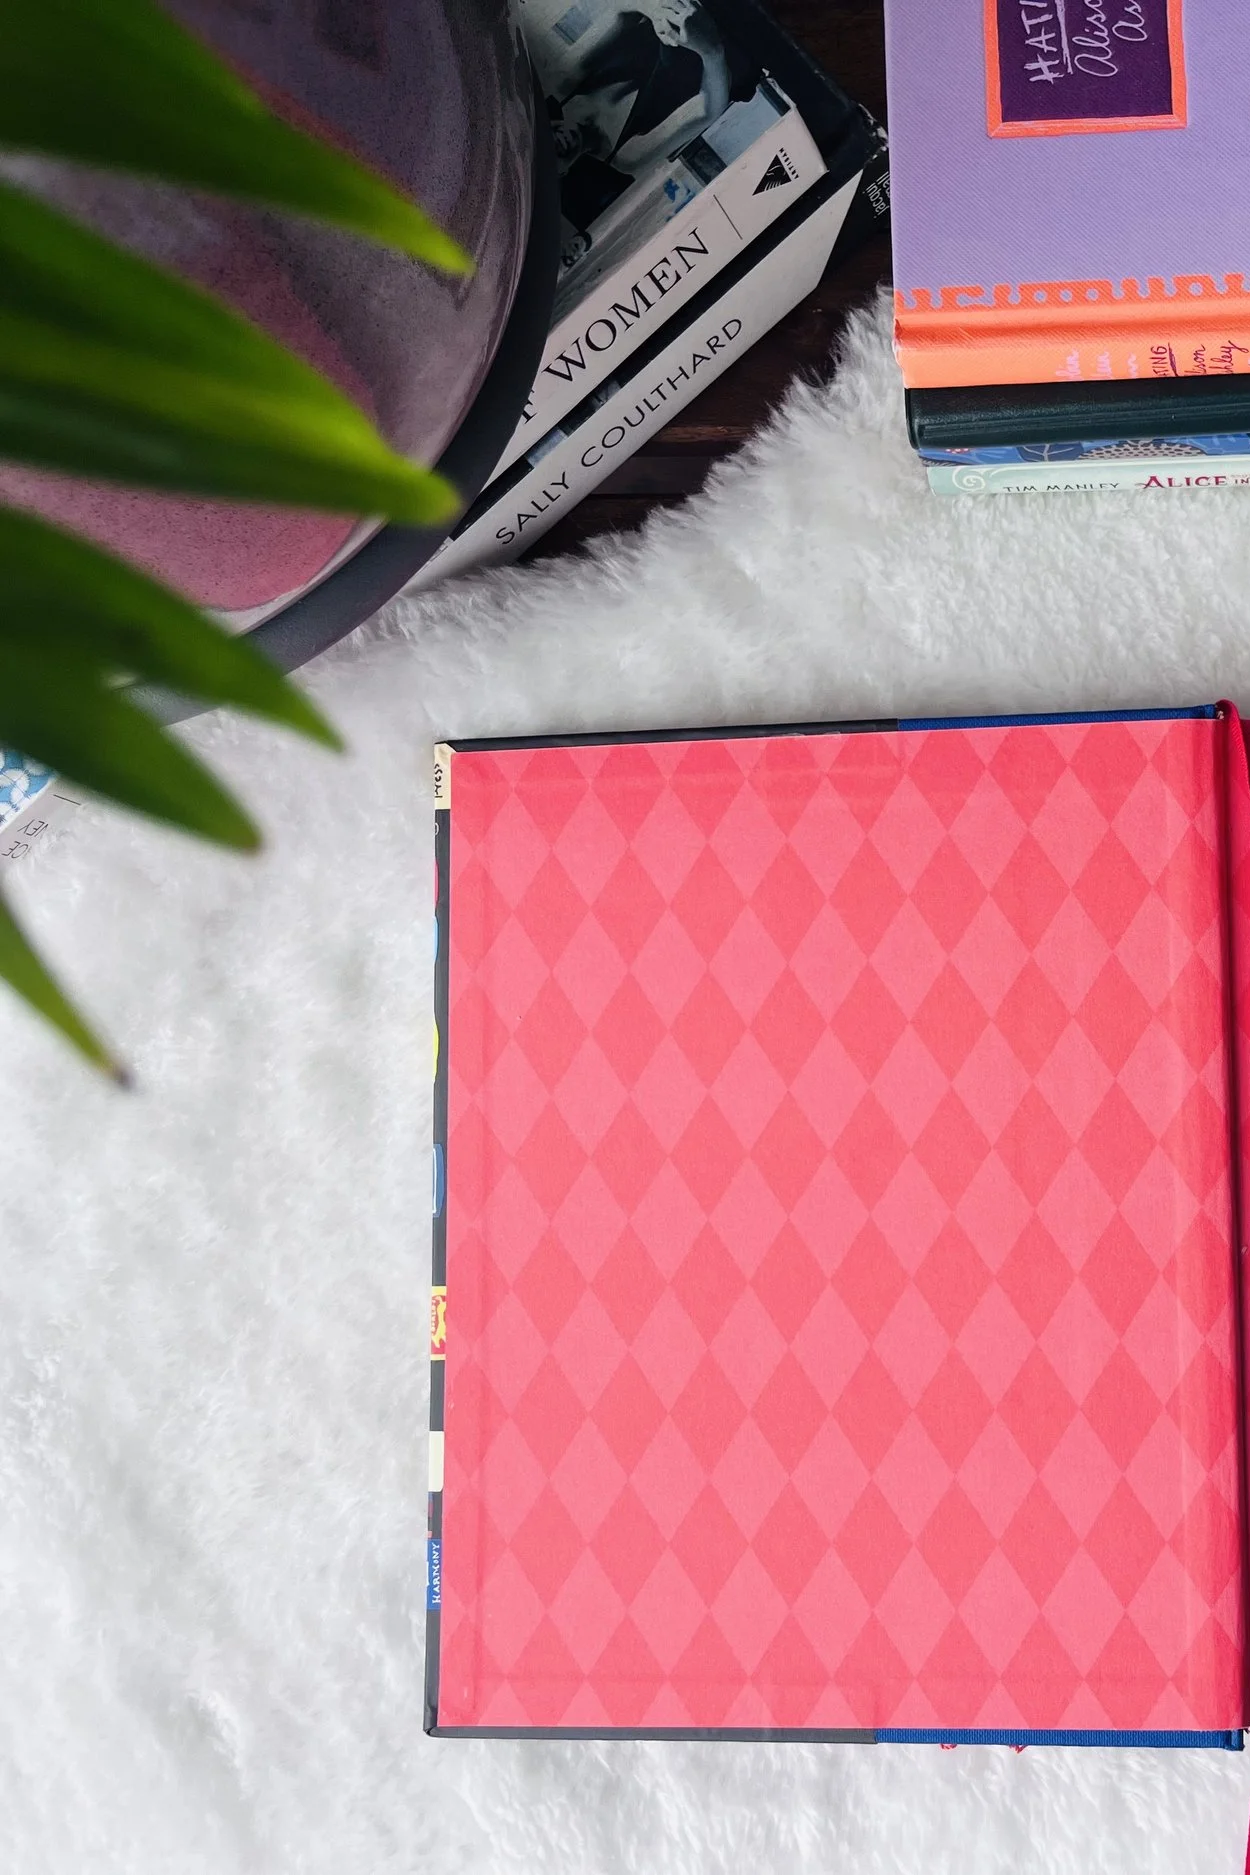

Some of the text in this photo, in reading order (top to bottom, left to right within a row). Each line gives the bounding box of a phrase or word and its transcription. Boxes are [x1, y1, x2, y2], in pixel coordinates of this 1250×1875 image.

[1019, 0, 1065, 85] HATI
[541, 226, 710, 383] WOMEN
[496, 319, 742, 546] SALLY COULTHARD
[1003, 485, 1037, 493] TIM
[1135, 475, 1228, 489] ALICE
[431, 1541, 441, 1604] HARMONY
